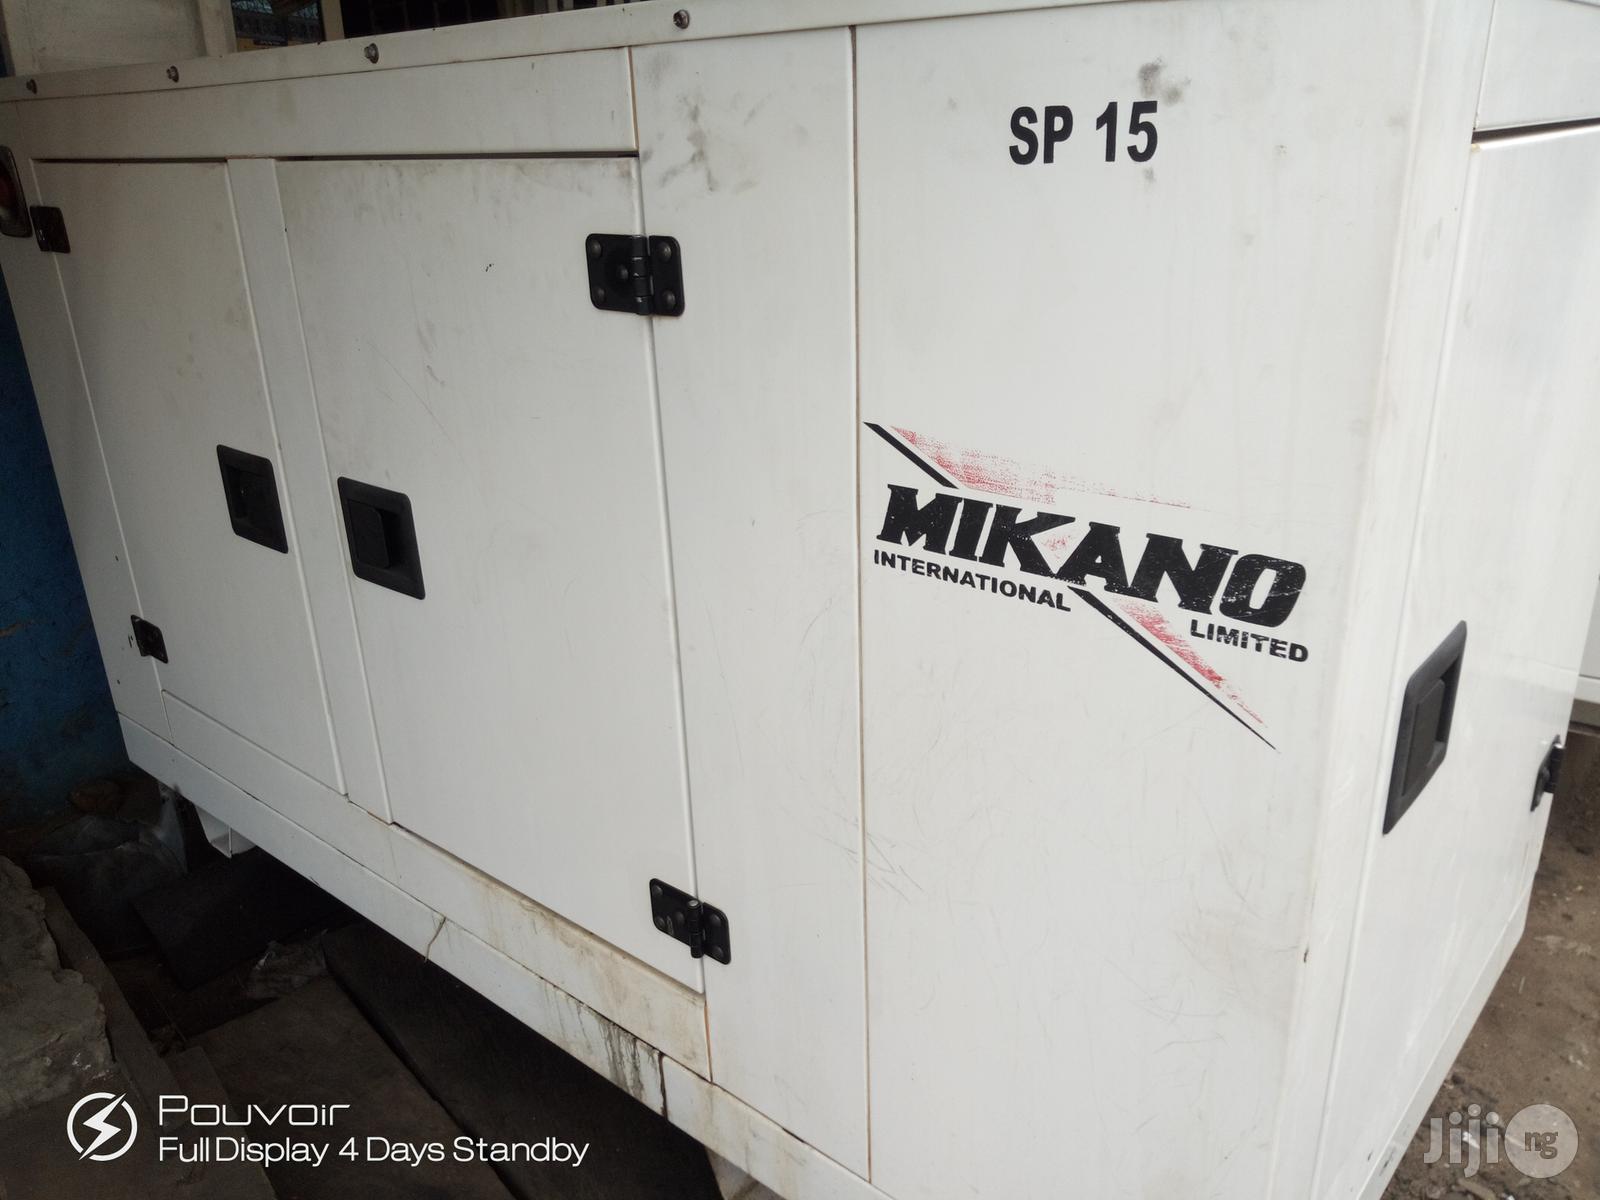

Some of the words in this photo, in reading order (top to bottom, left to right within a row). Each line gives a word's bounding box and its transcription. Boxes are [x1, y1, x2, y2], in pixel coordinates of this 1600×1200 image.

[1009, 105, 1073, 165] SP
[1096, 101, 1158, 162] 15
[874, 549, 1072, 612] INTERNATIONAL
[876, 483, 1307, 628] MIKANO
[1190, 619, 1309, 663] LIMITED
